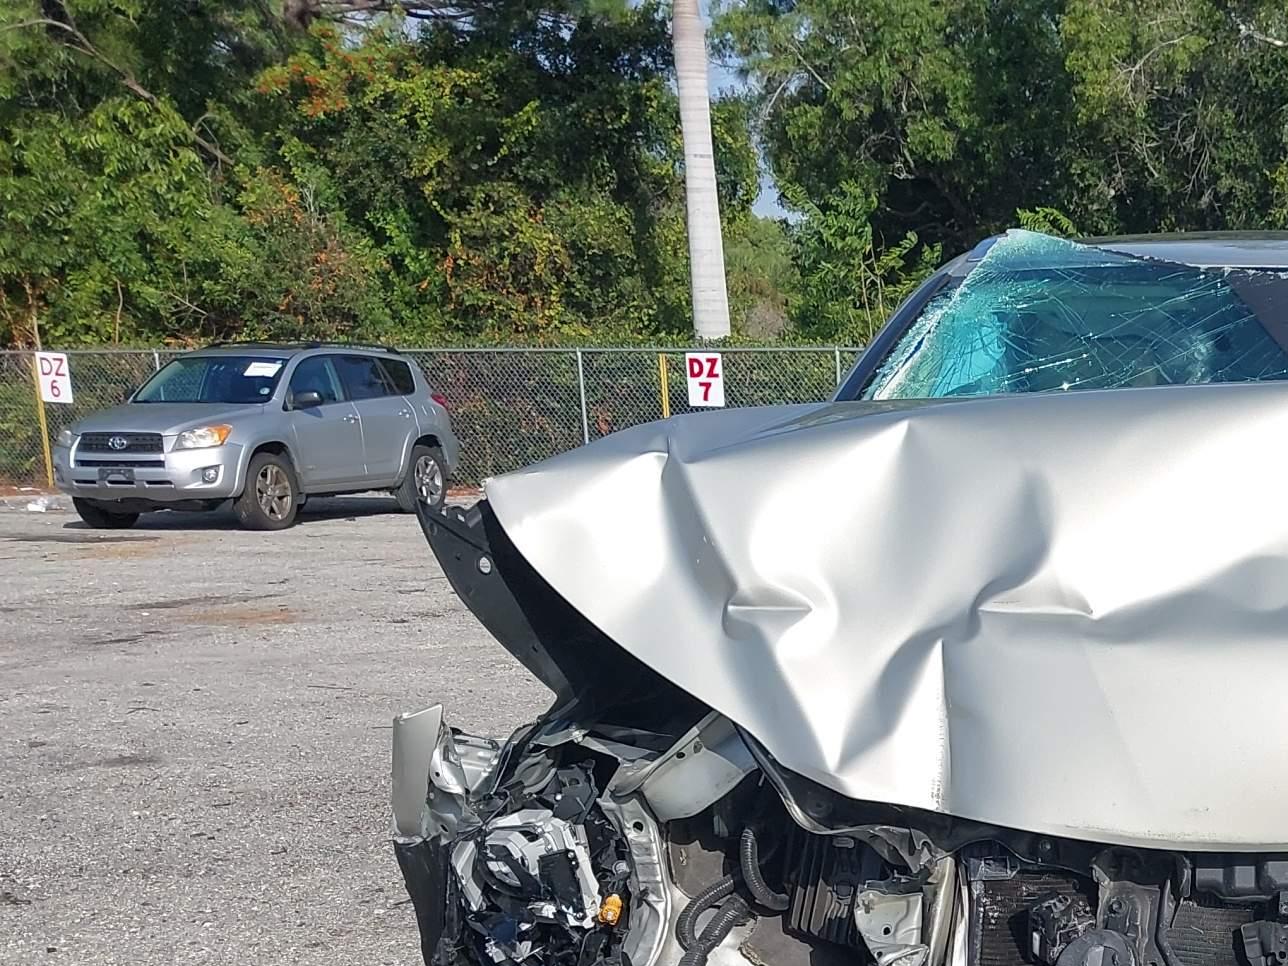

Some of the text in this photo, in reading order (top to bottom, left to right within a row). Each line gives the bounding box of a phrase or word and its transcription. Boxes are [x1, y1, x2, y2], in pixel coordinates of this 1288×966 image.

[39, 356, 66, 377] DZ
[688, 357, 719, 378] DZ
[50, 379, 61, 398] 6
[698, 381, 712, 402] 7
